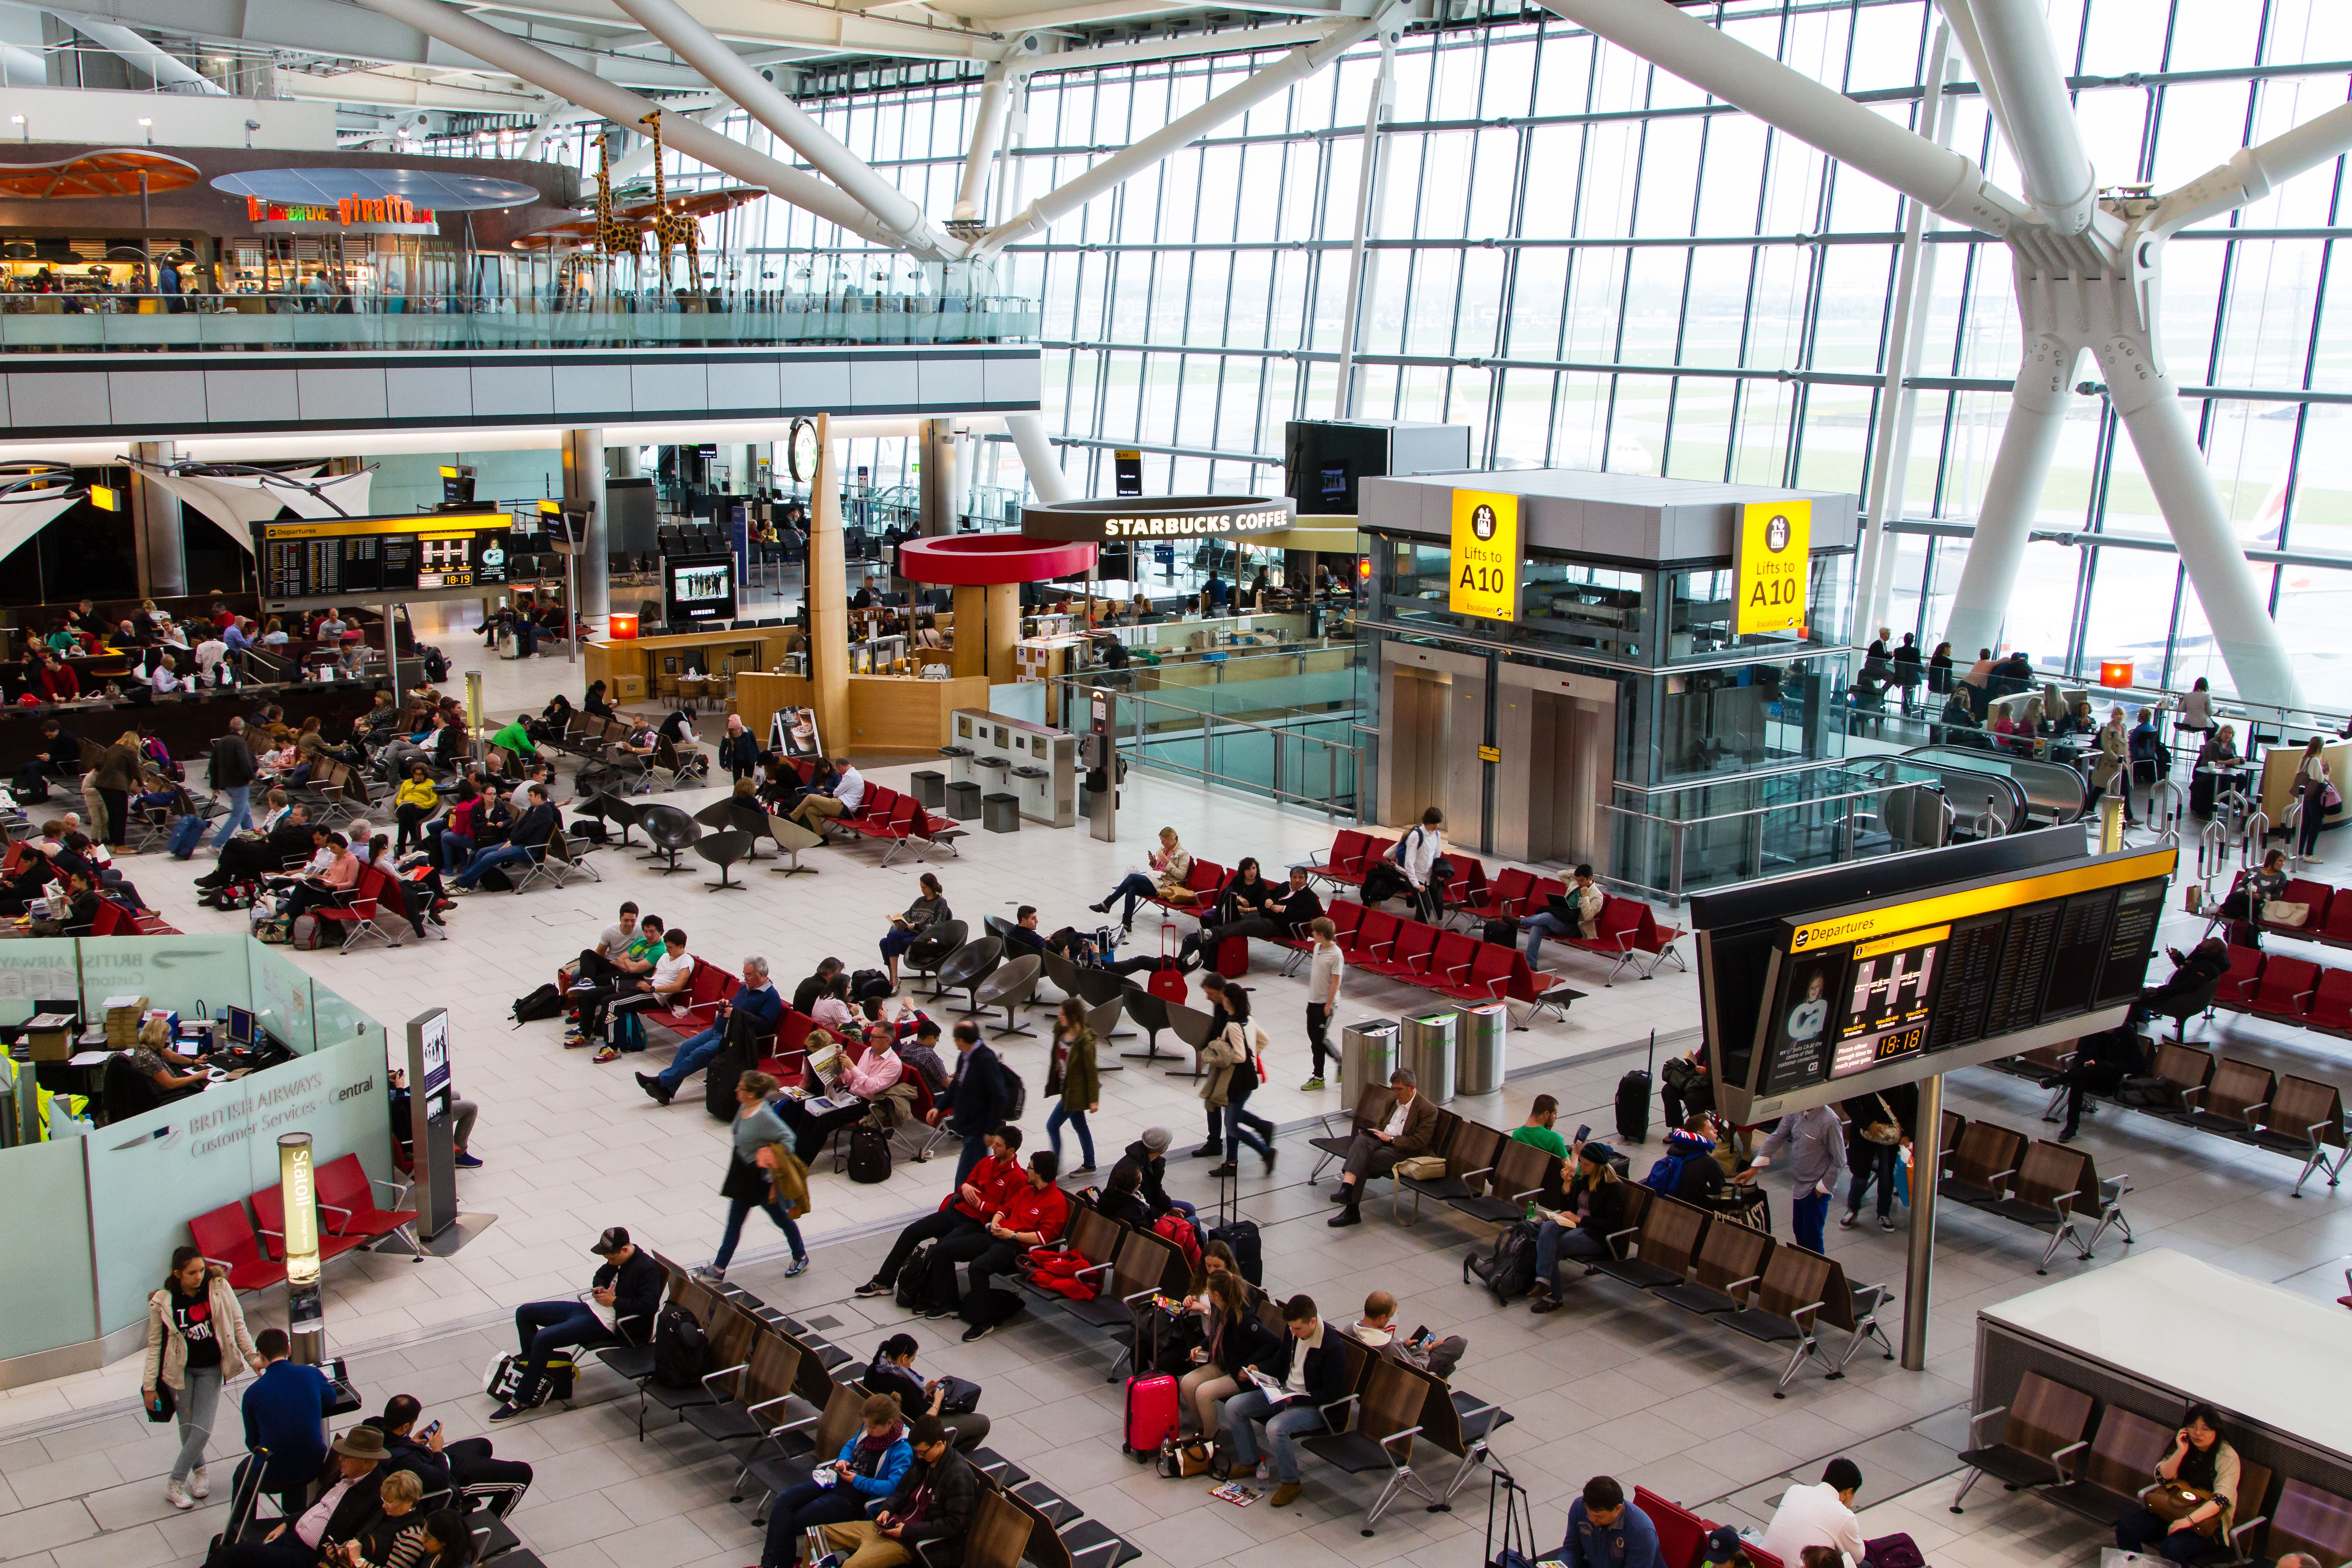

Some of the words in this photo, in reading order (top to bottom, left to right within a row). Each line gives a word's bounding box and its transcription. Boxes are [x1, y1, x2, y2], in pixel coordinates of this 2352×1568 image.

[338, 193, 413, 225] giraffe
[1105, 514, 1231, 536] STARBUCKS
[1235, 509, 1288, 531] COFFEE
[1465, 546, 1487, 561] Lifts
[1490, 551, 1502, 563] to
[1757, 561, 1780, 575] Lifts
[1784, 561, 1795, 573] to
[446, 575, 470, 584] 18:19
[1460, 564, 1504, 593] A10
[1750, 578, 1795, 607] A10
[1467, 603, 1495, 614] Escalators
[1757, 619, 1786, 628] Escalators
[2116, 803, 2125, 837] Statoil
[1811, 918, 1875, 941] Departures
[1864, 941, 1889, 953] Terminal
[1863, 965, 1869, 973] A
[1896, 957, 1902, 965] B
[605, 1016, 618, 1024] adidas
[1788, 999, 1828, 1042] ca
[1853, 1043, 1868, 1051] allow
[1880, 1029, 1920, 1056] 18:18
[1834, 1062, 1848, 1070] reach
[1848, 1060, 1860, 1068] your
[1860, 1057, 1872, 1065] gate
[1836, 1053, 1855, 1062] enough
[189, 1097, 253, 1135] BRITISH
[258, 1071, 323, 1111] AIRWAYS
[191, 1122, 258, 1157] Customer
[262, 1100, 316, 1131] Services
[329, 1075, 373, 1104] Central
[293, 1150, 311, 1206] Statoil
[176, 1308, 188, 1328] I
